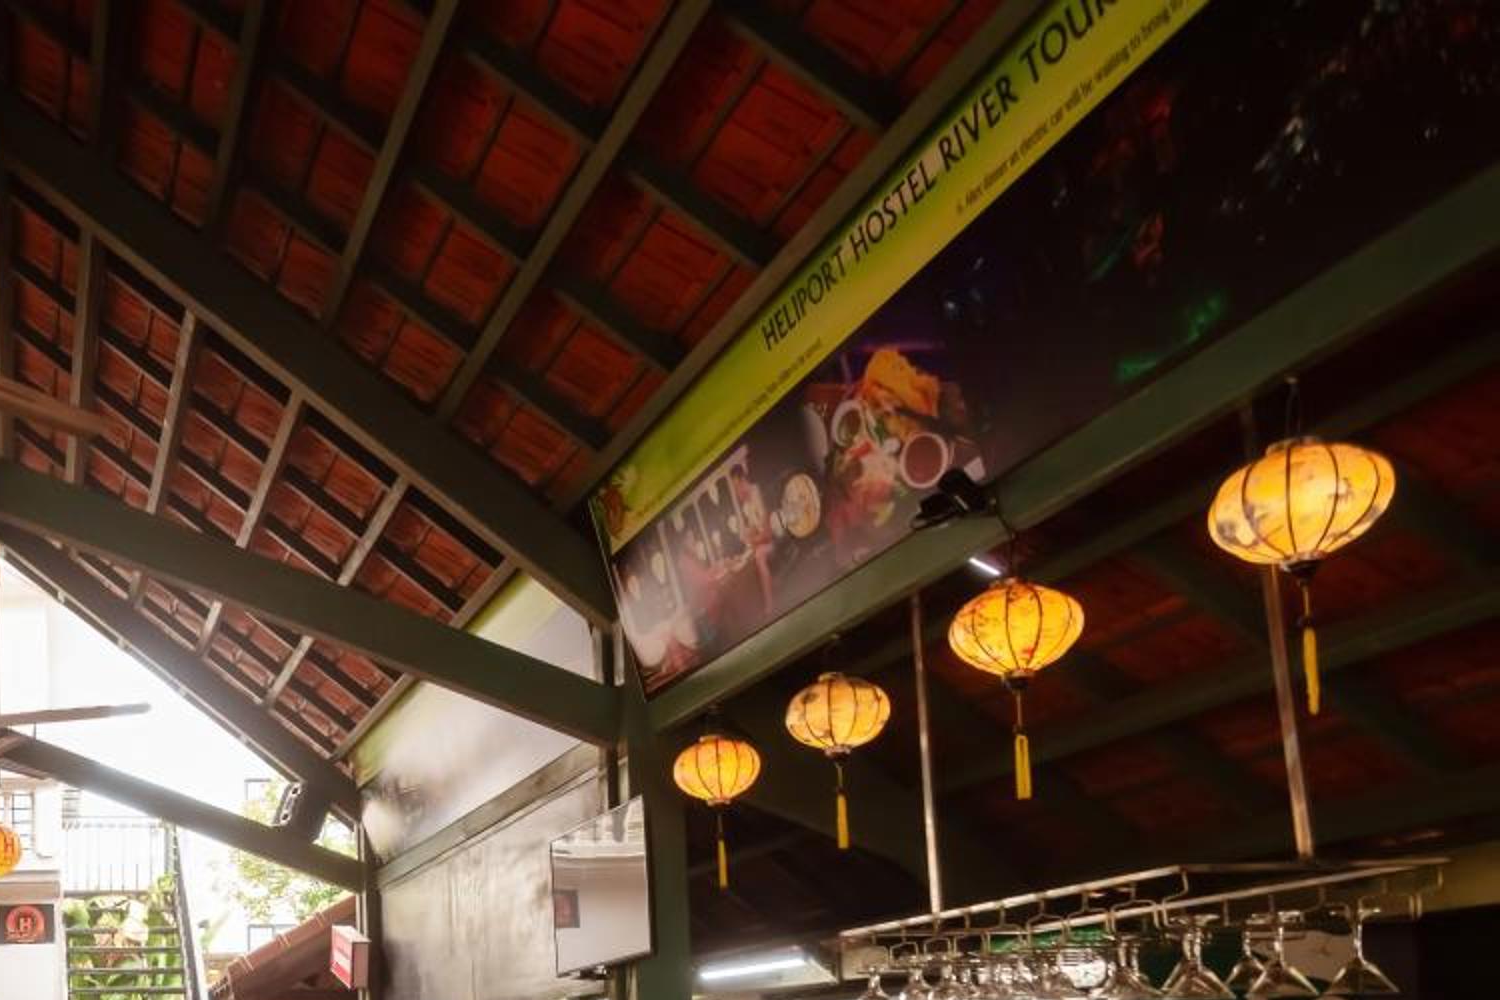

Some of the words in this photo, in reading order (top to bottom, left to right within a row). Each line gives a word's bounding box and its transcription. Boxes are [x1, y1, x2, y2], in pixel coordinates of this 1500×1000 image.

[761, 246, 845, 350] HELIPORT
[850, 160, 937, 263] HOSTEL
[938, 76, 1019, 172] RIVER
